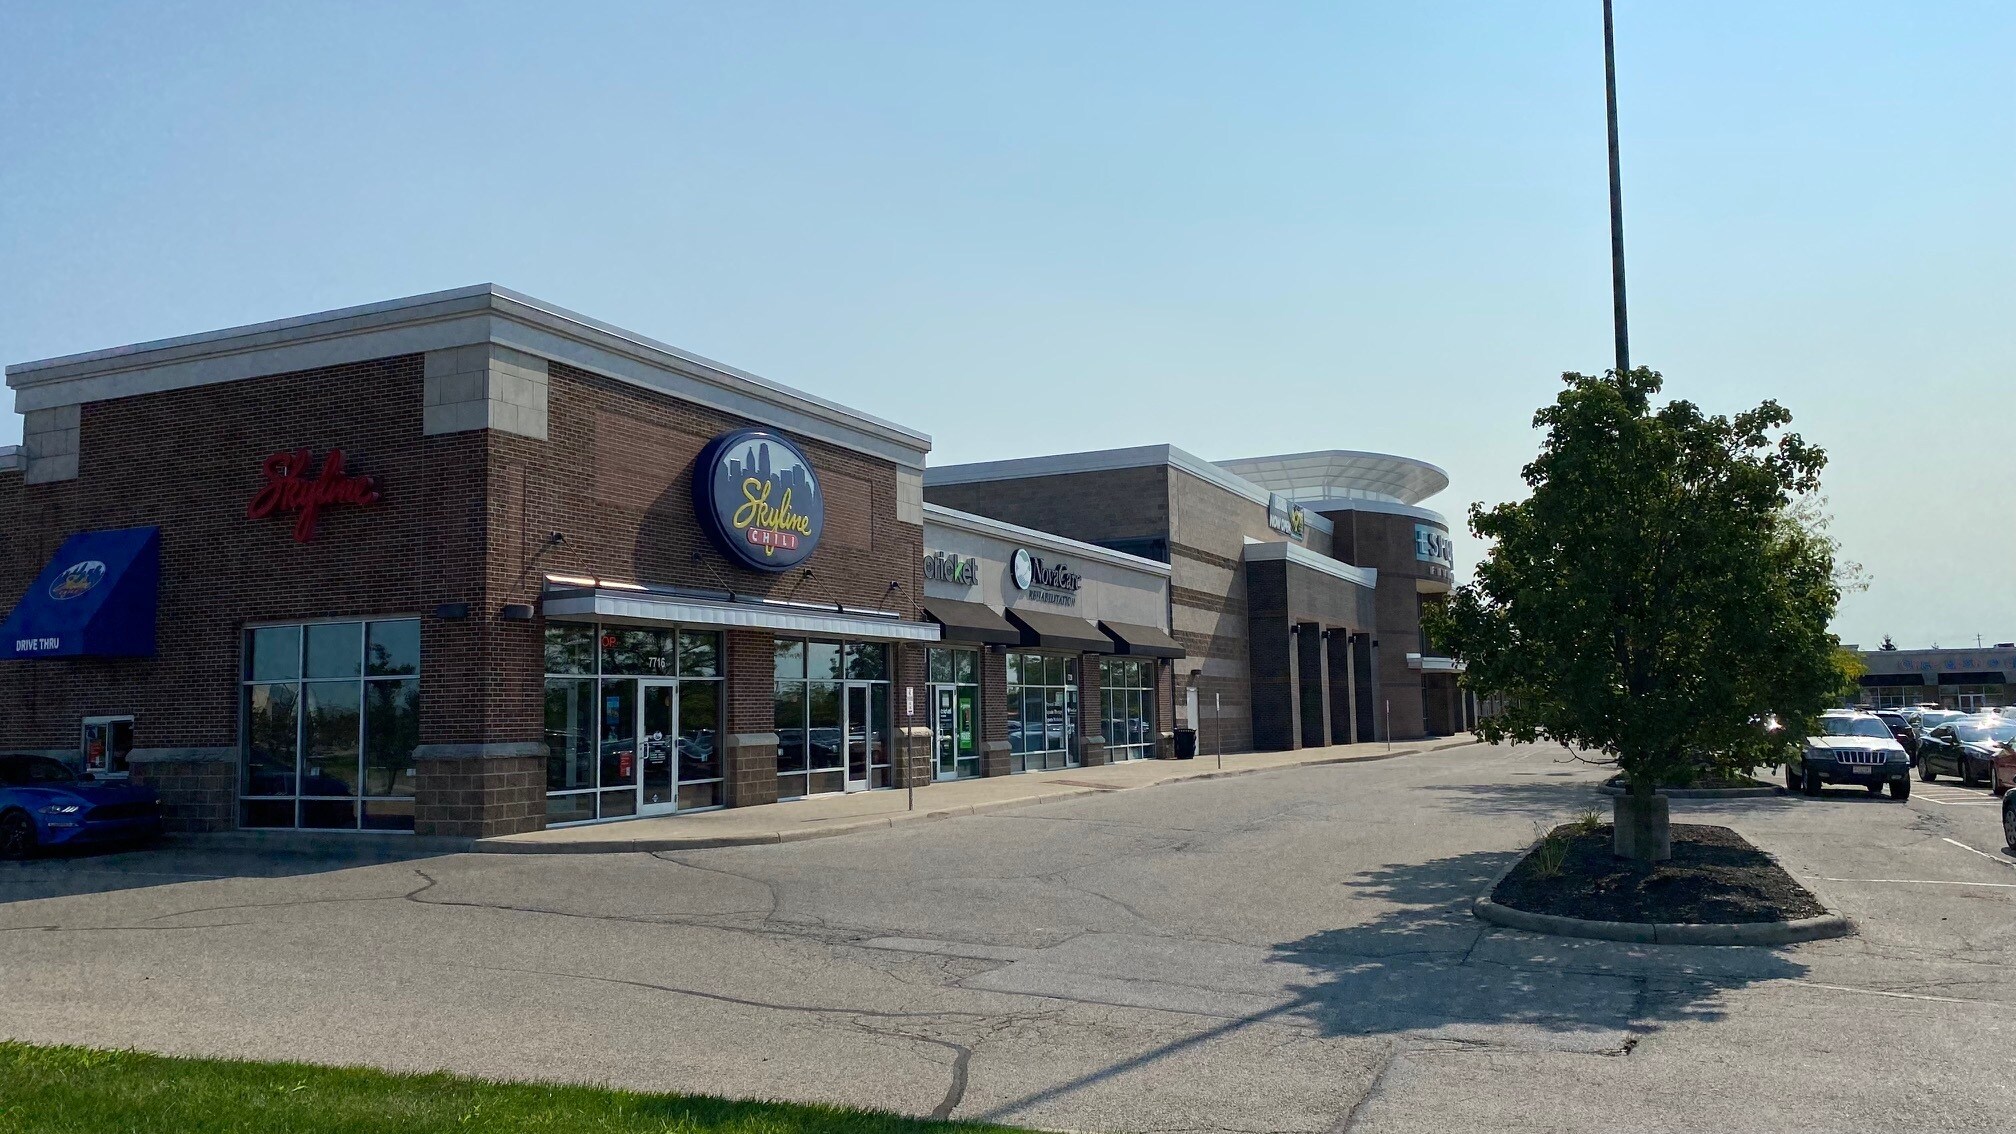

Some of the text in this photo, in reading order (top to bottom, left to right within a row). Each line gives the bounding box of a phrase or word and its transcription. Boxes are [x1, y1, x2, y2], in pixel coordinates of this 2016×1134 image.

[247, 447, 379, 543] Skyline
[733, 477, 812, 556] Skyline
[751, 529, 795, 548] CHILI
[923, 551, 978, 586] cricket
[1030, 556, 1082, 591] NovaCare
[1029, 589, 1077, 607] REHABILITATION
[16, 637, 60, 651] DRIVE THRU
[648, 656, 667, 668] 7716
